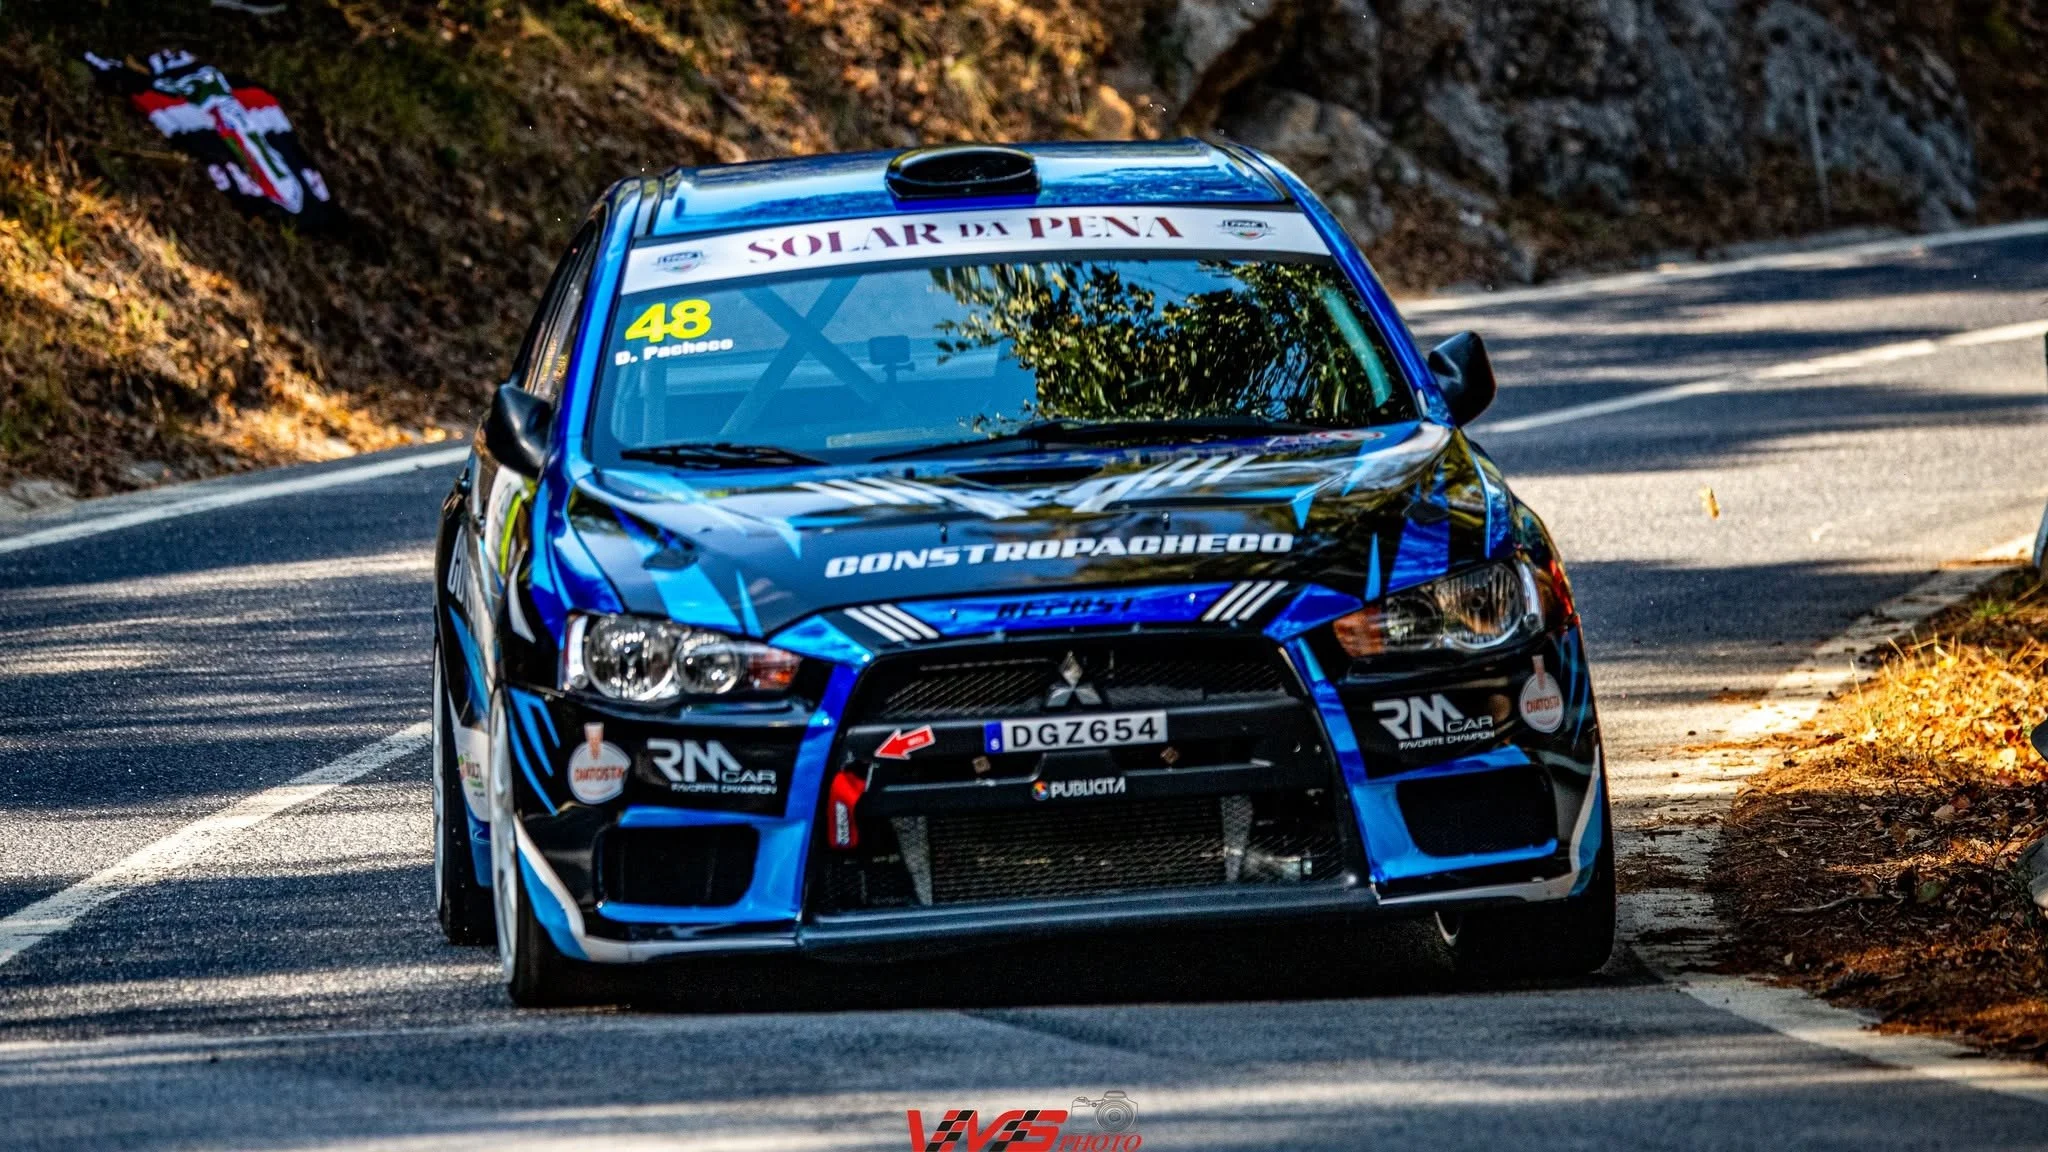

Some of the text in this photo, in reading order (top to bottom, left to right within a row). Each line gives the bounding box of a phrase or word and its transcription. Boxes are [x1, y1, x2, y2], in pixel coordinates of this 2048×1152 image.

[748, 215, 1185, 264] SOLAR DA PENA
[624, 298, 712, 343] 48
[643, 337, 734, 361] Pacheco
[824, 532, 1296, 579] CONSTROPACHECO
[1011, 716, 1158, 748] DGZ654
[1371, 692, 1494, 741] RM CAR
[646, 737, 777, 784] RM CAR
[1399, 729, 1496, 751] FAVORITE CHAMPION
[671, 782, 719, 793] FAVORITE
